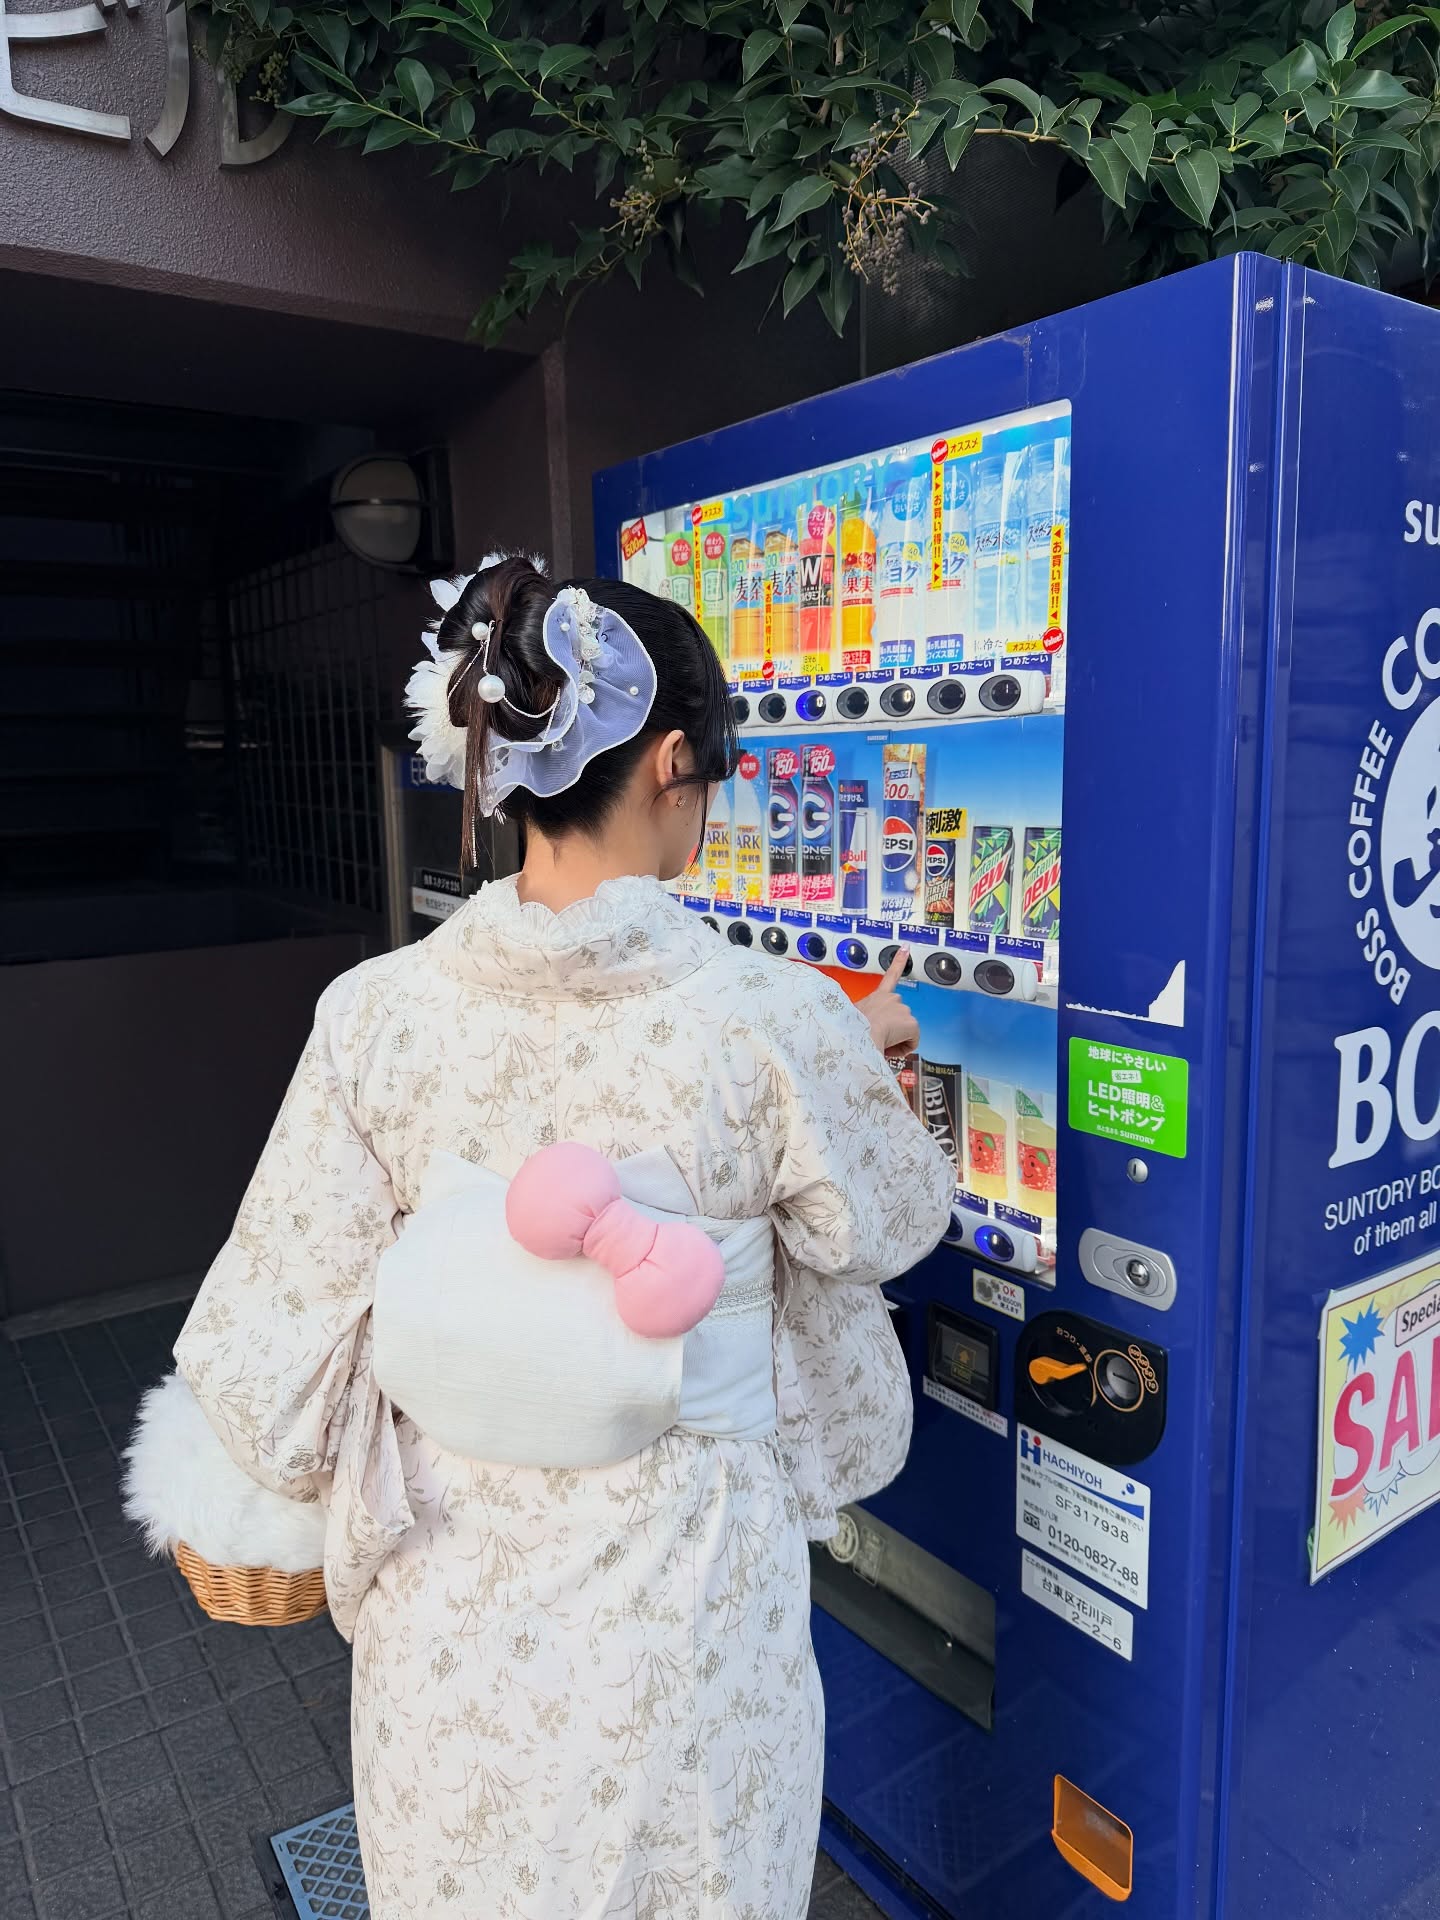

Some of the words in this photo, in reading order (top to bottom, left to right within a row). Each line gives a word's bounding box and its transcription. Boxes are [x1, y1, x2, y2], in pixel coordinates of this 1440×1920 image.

[950, 437, 979, 453] オススメ
[951, 536, 965, 546] 540
[770, 569, 799, 597] 麦茶
[800, 556, 820, 588] W
[847, 576, 873, 593] 果実
[1050, 541, 1064, 609] お買い得!!
[736, 575, 765, 602] 麦茶
[1012, 642, 1038, 651] オススメ
[1044, 633, 1064, 647] Value!
[1348, 719, 1394, 899] COFFEE
[848, 849, 867, 862] Bull
[1355, 905, 1411, 1006] BOSS
[1088, 1045, 1168, 1072] 地球にやさしい
[1114, 1072, 1140, 1081] 省エネ!
[1088, 1080, 1166, 1113] LED照明&
[1088, 1100, 1166, 1132] ヒートポンプ
[1324, 1174, 1417, 1231] SUNTORY
[1354, 1226, 1372, 1256] of
[1375, 1215, 1415, 1247] them
[1418, 1200, 1438, 1230] all
[1003, 1285, 1016, 1298] OK
[1043, 1448, 1103, 1489] HACHIYOH
[1055, 1494, 1130, 1544] SF317938
[1048, 1525, 1140, 1587] 0120-0827-88
[1041, 1578, 1113, 1626] 台東区花川戸
